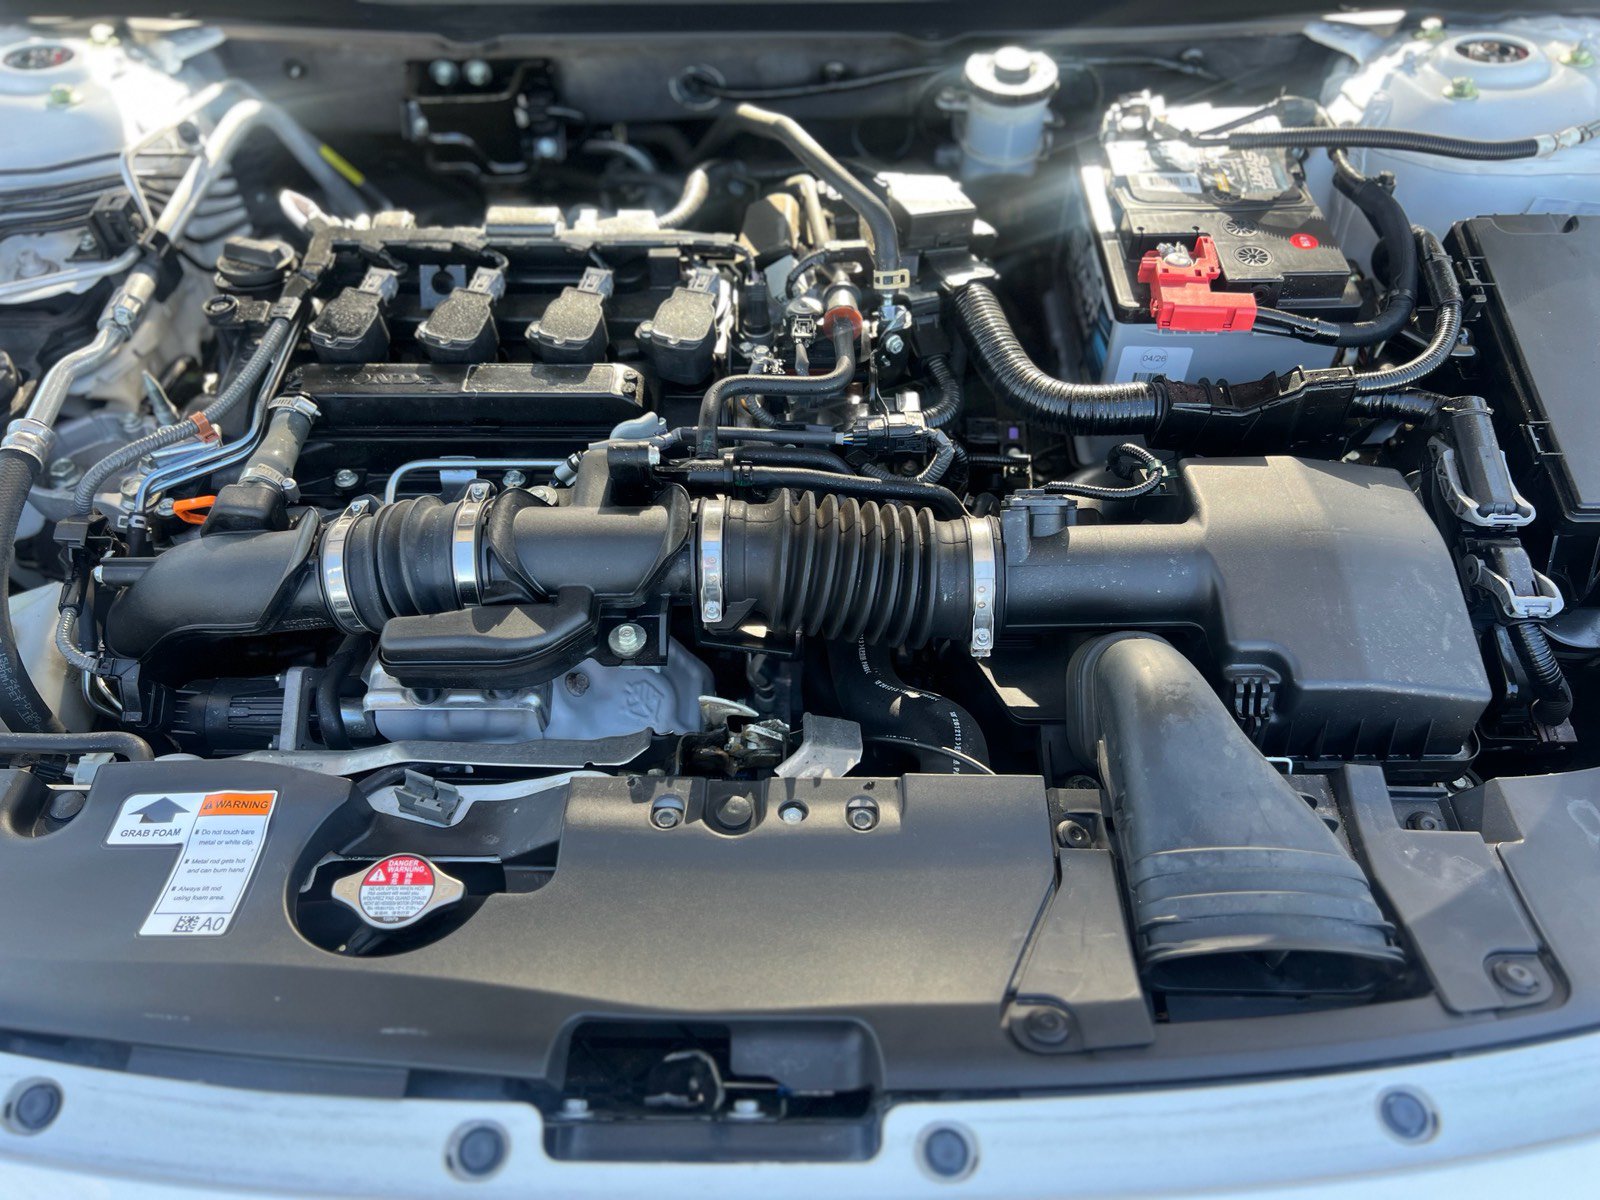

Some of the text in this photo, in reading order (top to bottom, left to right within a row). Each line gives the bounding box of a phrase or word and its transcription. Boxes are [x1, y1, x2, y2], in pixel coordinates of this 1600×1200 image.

[215, 801, 269, 809] WARNING
[152, 828, 182, 837] FOAM
[242, 839, 254, 847] clip.
[197, 916, 225, 931] A0
